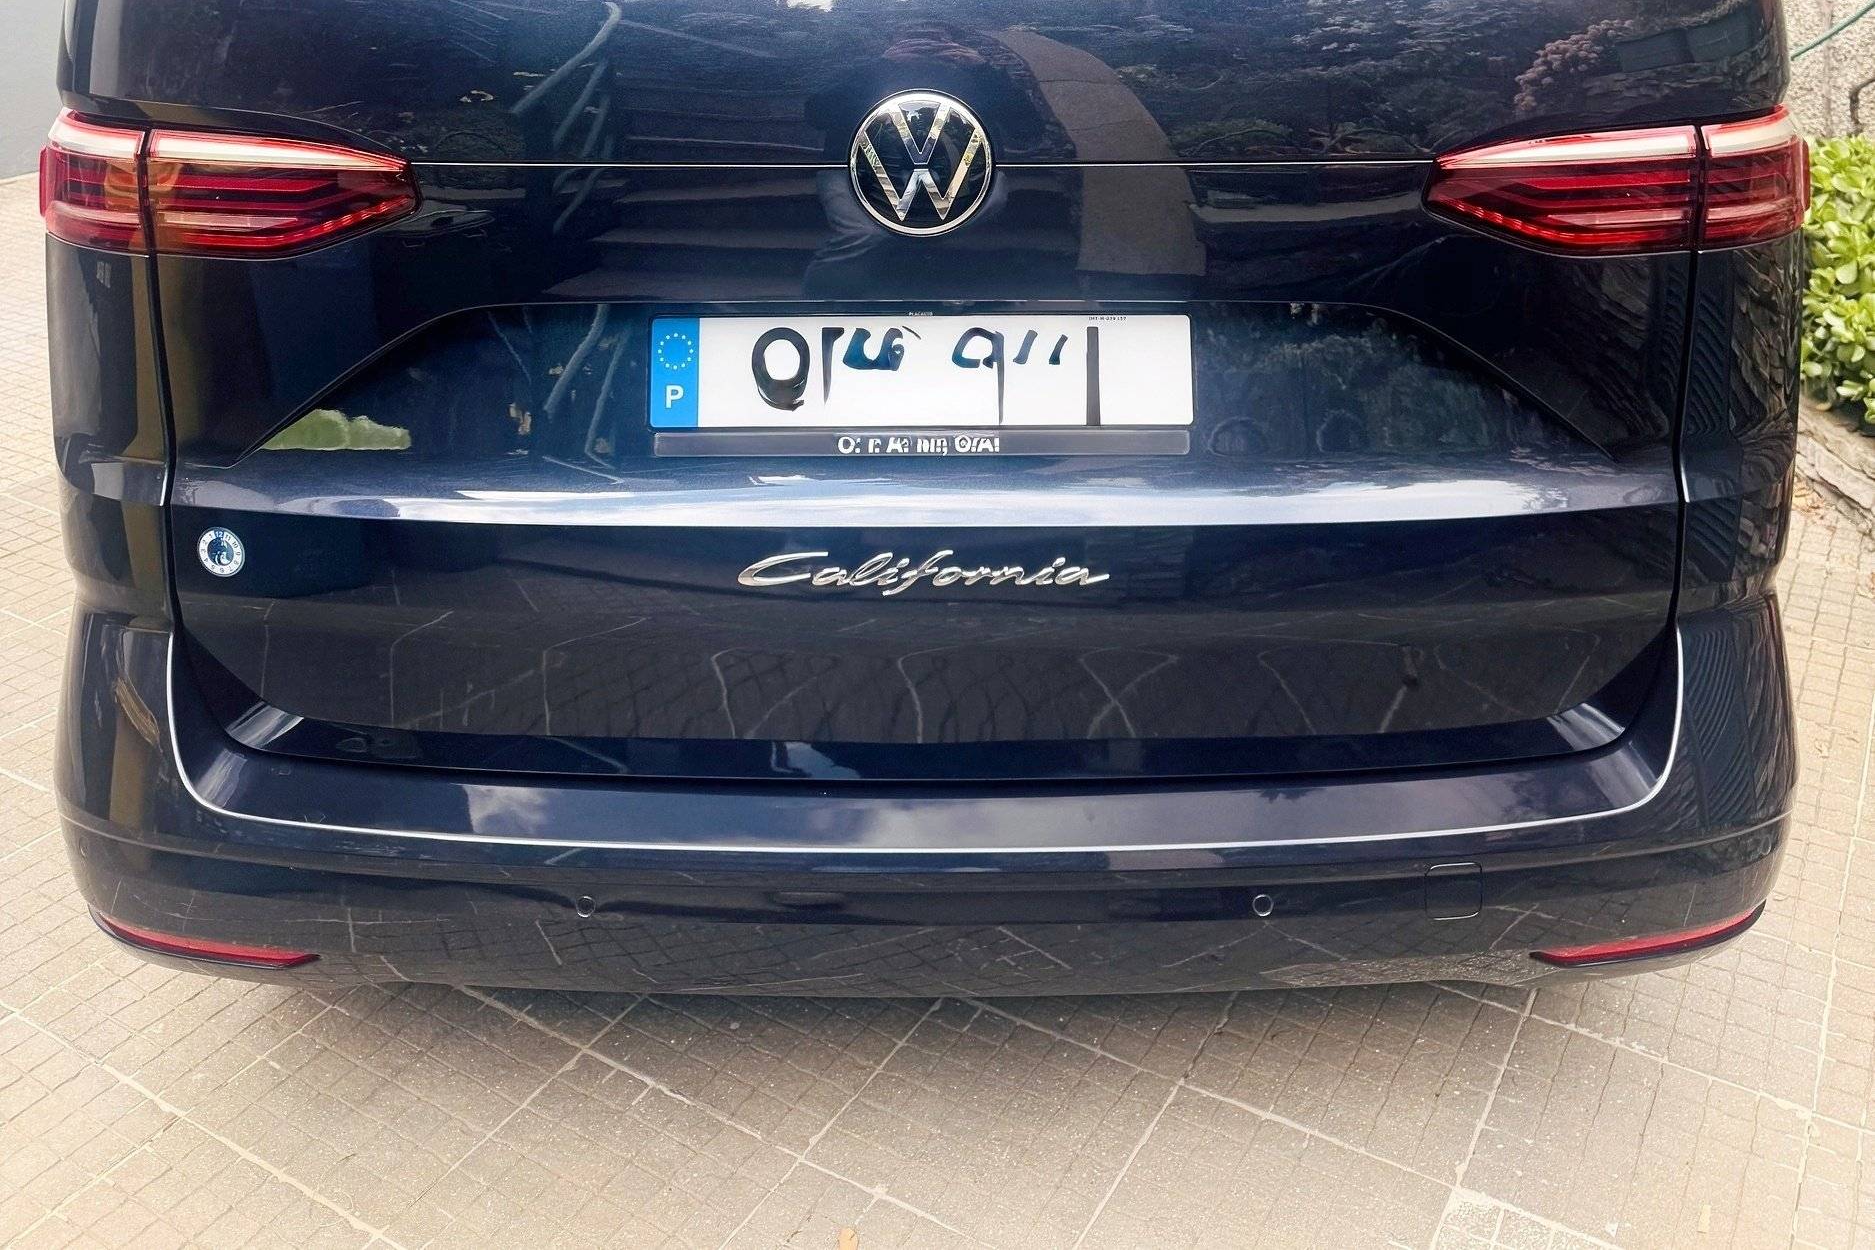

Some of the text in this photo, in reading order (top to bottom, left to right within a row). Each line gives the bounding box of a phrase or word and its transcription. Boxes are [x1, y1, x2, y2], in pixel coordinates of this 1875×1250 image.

[852, 93, 988, 226] VW
[665, 384, 684, 409] P
[737, 549, 1110, 596] California
